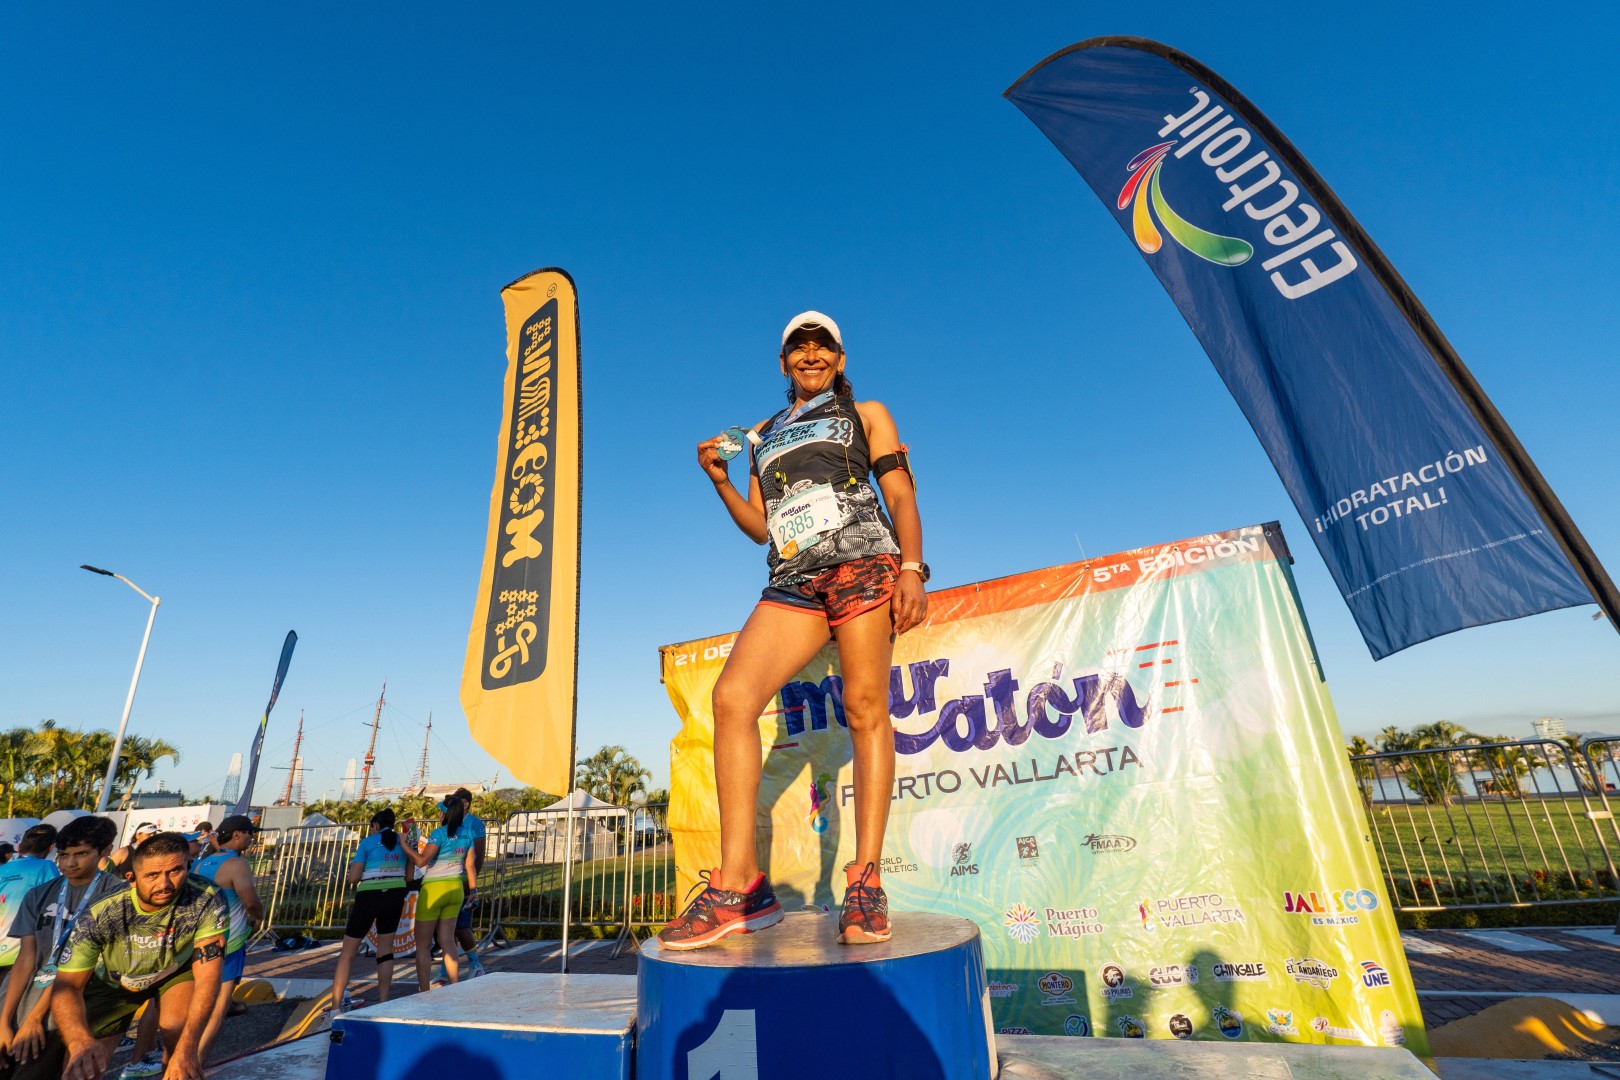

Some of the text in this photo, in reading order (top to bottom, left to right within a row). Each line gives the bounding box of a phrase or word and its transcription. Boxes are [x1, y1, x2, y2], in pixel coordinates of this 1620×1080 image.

[1158, 90, 1358, 300] Electrolit
[1315, 445, 1488, 533] ¡HIDRATACIÓN
[1356, 487, 1448, 531] TOTAL!
[778, 509, 815, 545] 2385
[1093, 537, 1260, 583] 5TA EDICIÓN
[674, 643, 733, 667] 21 DE
[969, 745, 1144, 789] VALLARTA
[1090, 840, 1122, 851] FMAA
[880, 857, 903, 866] ORLD
[880, 863, 918, 874] THLETICS
[950, 864, 980, 877] AIMS
[1157, 894, 1223, 913] PUERTO
[1046, 908, 1098, 921] Puerto
[1161, 909, 1246, 928] VALLARTA
[1312, 917, 1324, 925] ES
[1049, 921, 1104, 940] Mágico
[1213, 963, 1267, 978] CHINGALE
[1287, 965, 1295, 974] EL
[1299, 965, 1338, 978] ANDARIEGO
[1363, 972, 1390, 987] UNE
[1042, 980, 1070, 989] MONTERO
[687, 1009, 759, 1080] 1
